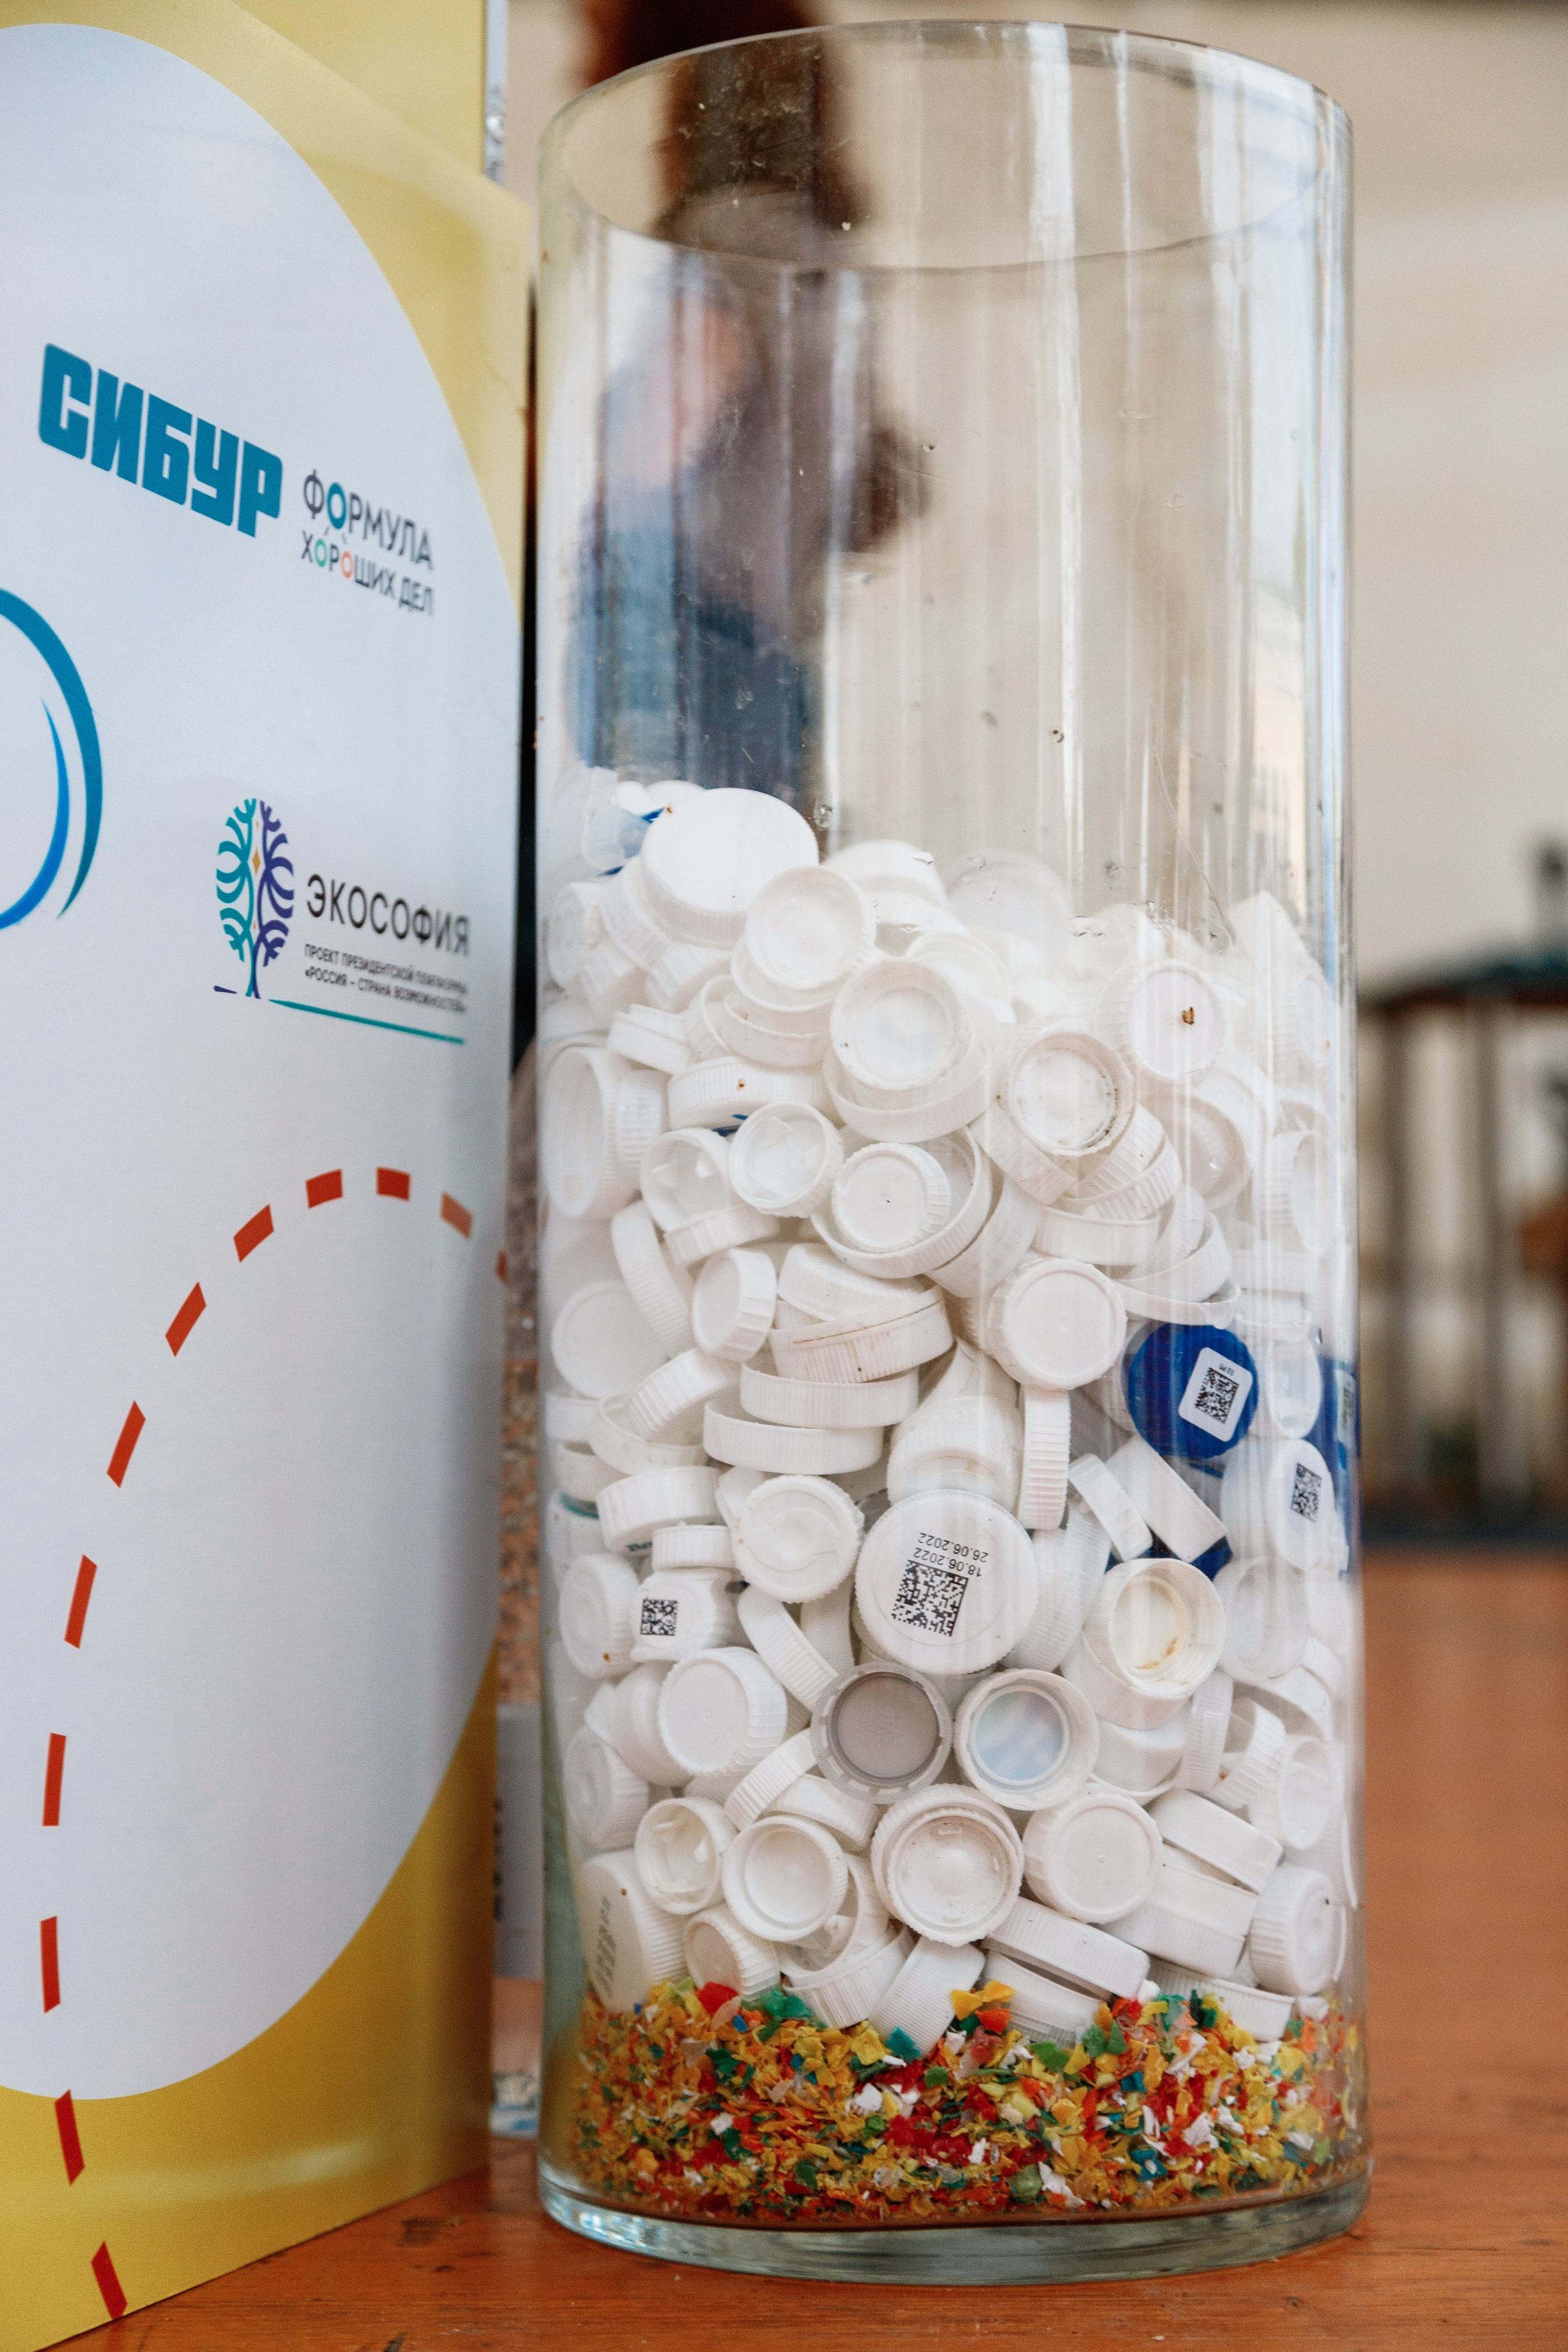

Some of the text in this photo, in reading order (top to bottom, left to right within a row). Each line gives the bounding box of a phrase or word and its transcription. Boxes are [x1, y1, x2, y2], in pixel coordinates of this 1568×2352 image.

[38, 342, 284, 538] СИБУР
[303, 469, 434, 570] ФОРМУЛА
[301, 530, 433, 615] ХОРОШИХ ДЕЛ
[306, 873, 470, 957] ЭКОСОФИЯ
[304, 943, 339, 965] ПРОЕКТ
[357, 977, 391, 997] СТРАНА
[913, 1547, 982, 1577] 18.06.2022
[918, 1532, 989, 1562] 26.06.2022
